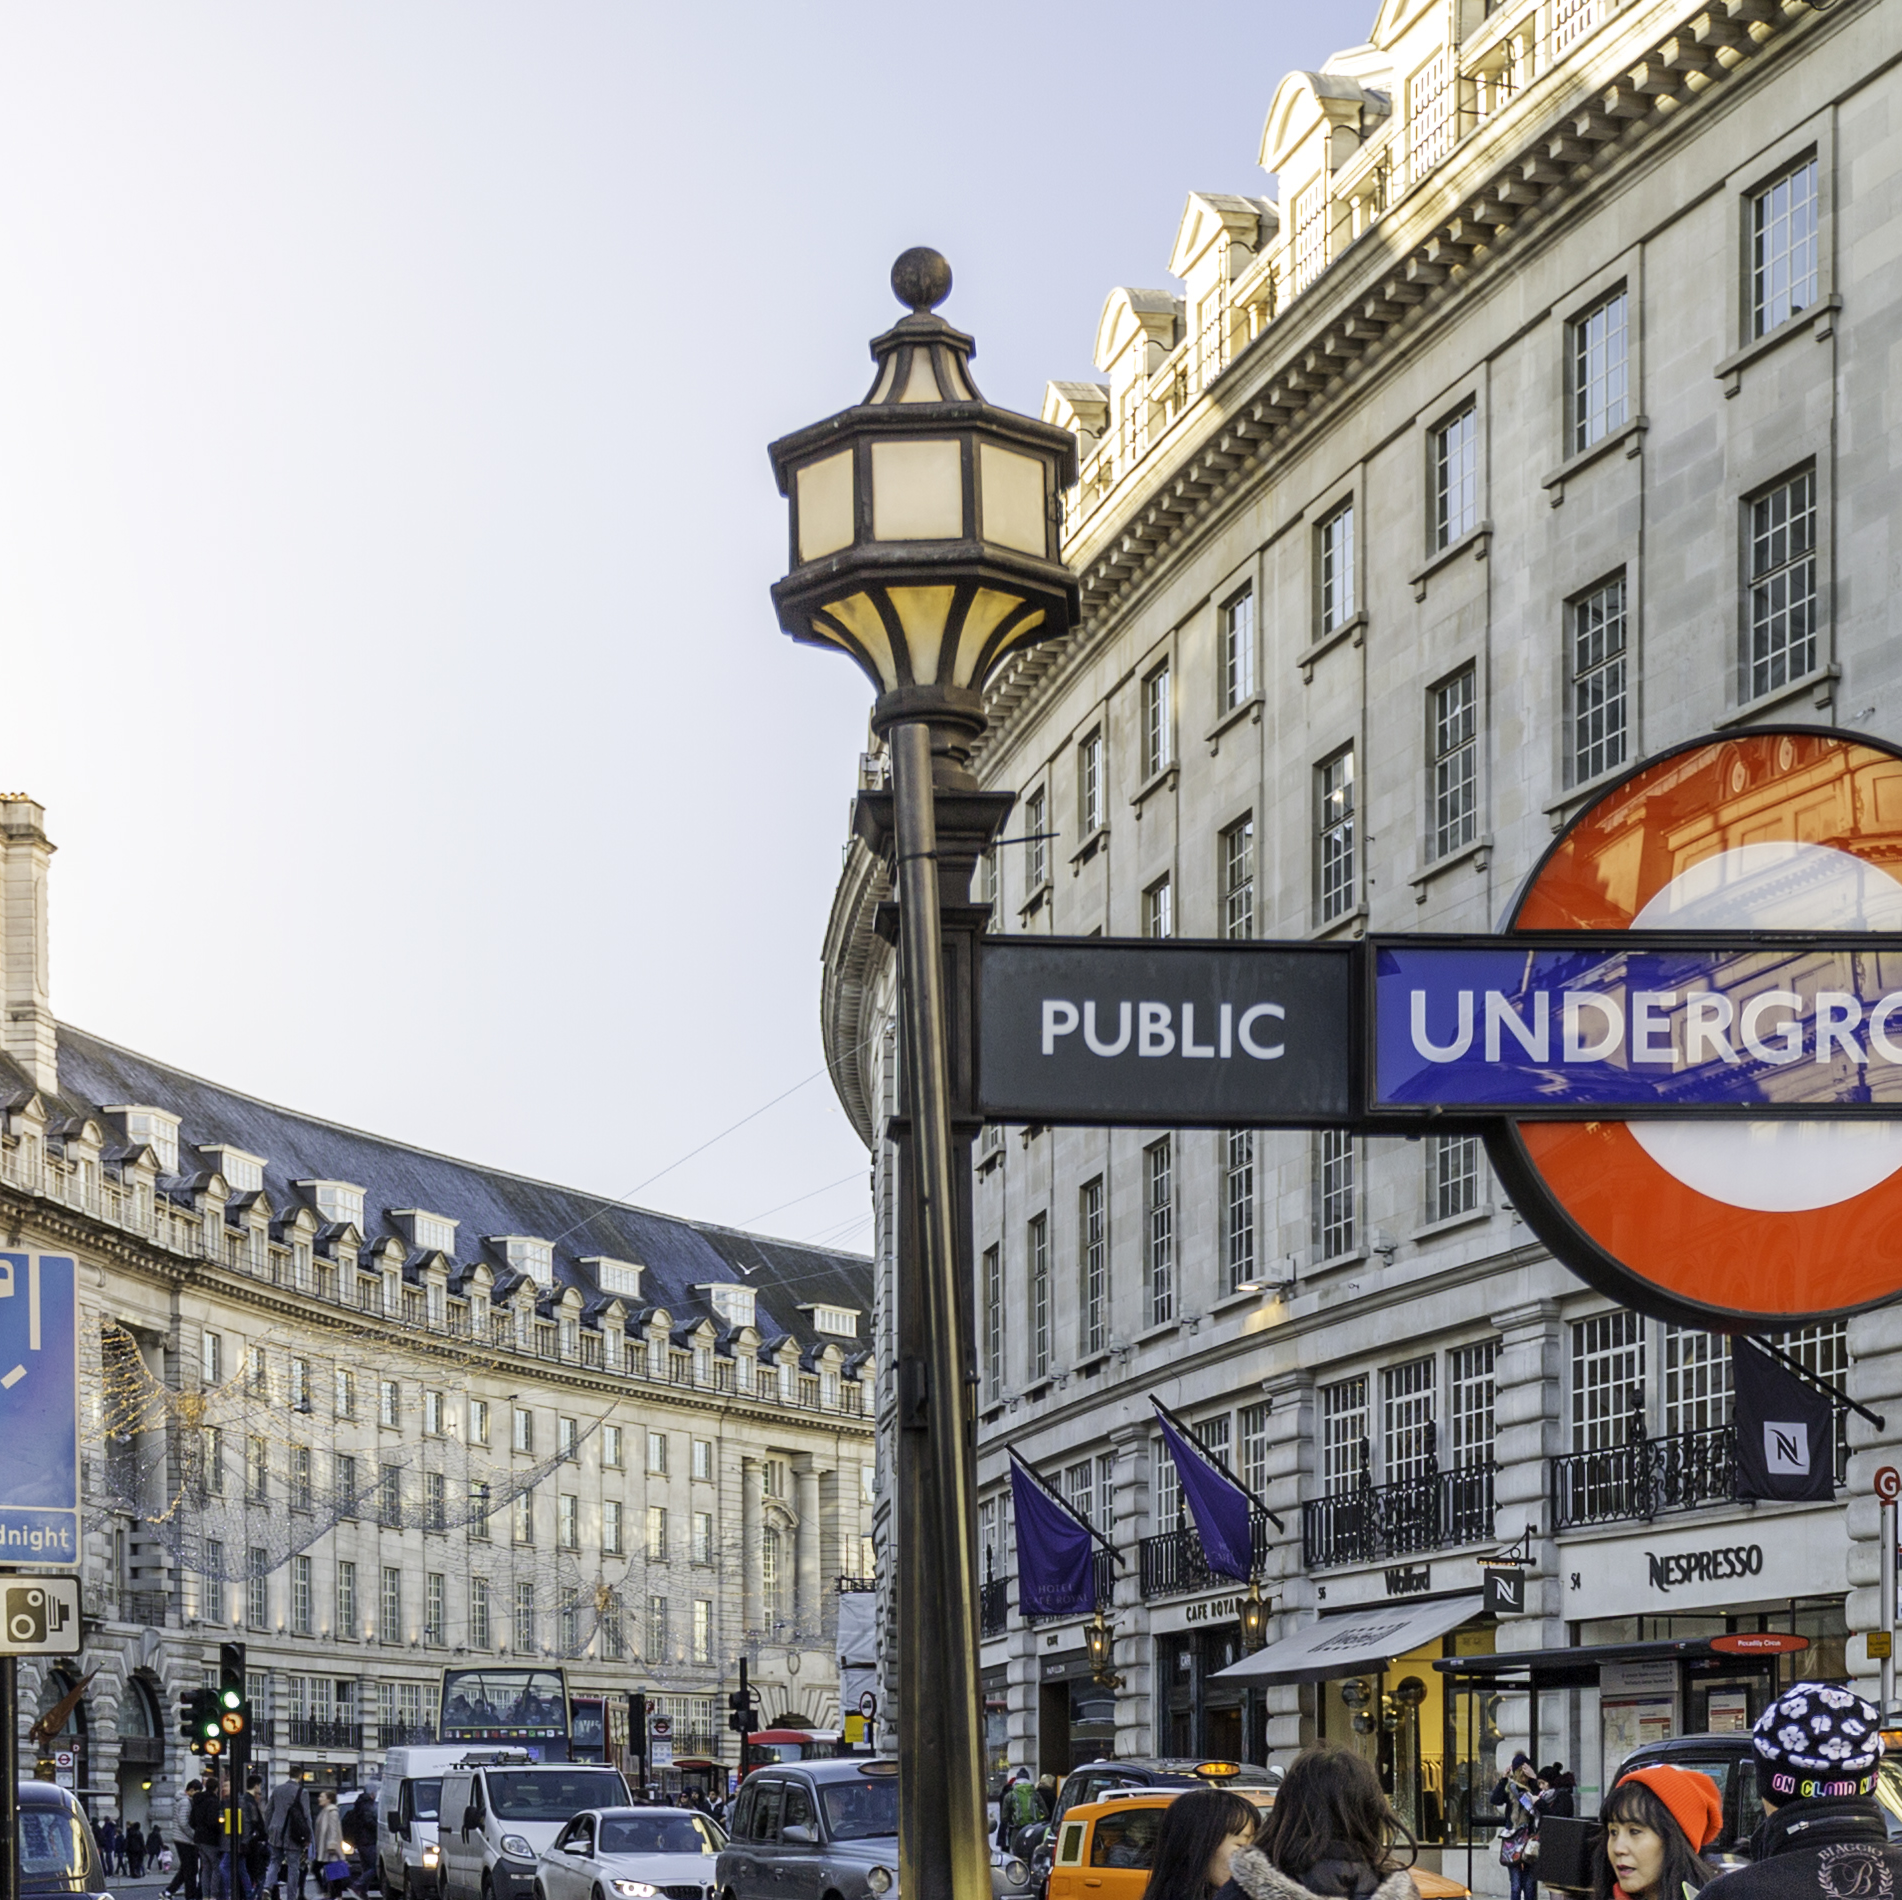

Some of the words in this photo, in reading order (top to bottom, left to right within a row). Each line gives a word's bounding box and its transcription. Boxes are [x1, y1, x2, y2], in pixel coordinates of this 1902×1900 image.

[1041, 1001, 1285, 1060] PUBLIC
[1880, 1471, 1897, 1496] G
[1644, 1544, 1764, 1593] NESPRESSO
[1211, 1599, 1239, 1618] ROYA
[1772, 1773, 1795, 1794] ON
[1817, 1843, 1883, 1860] BIAGGIO
